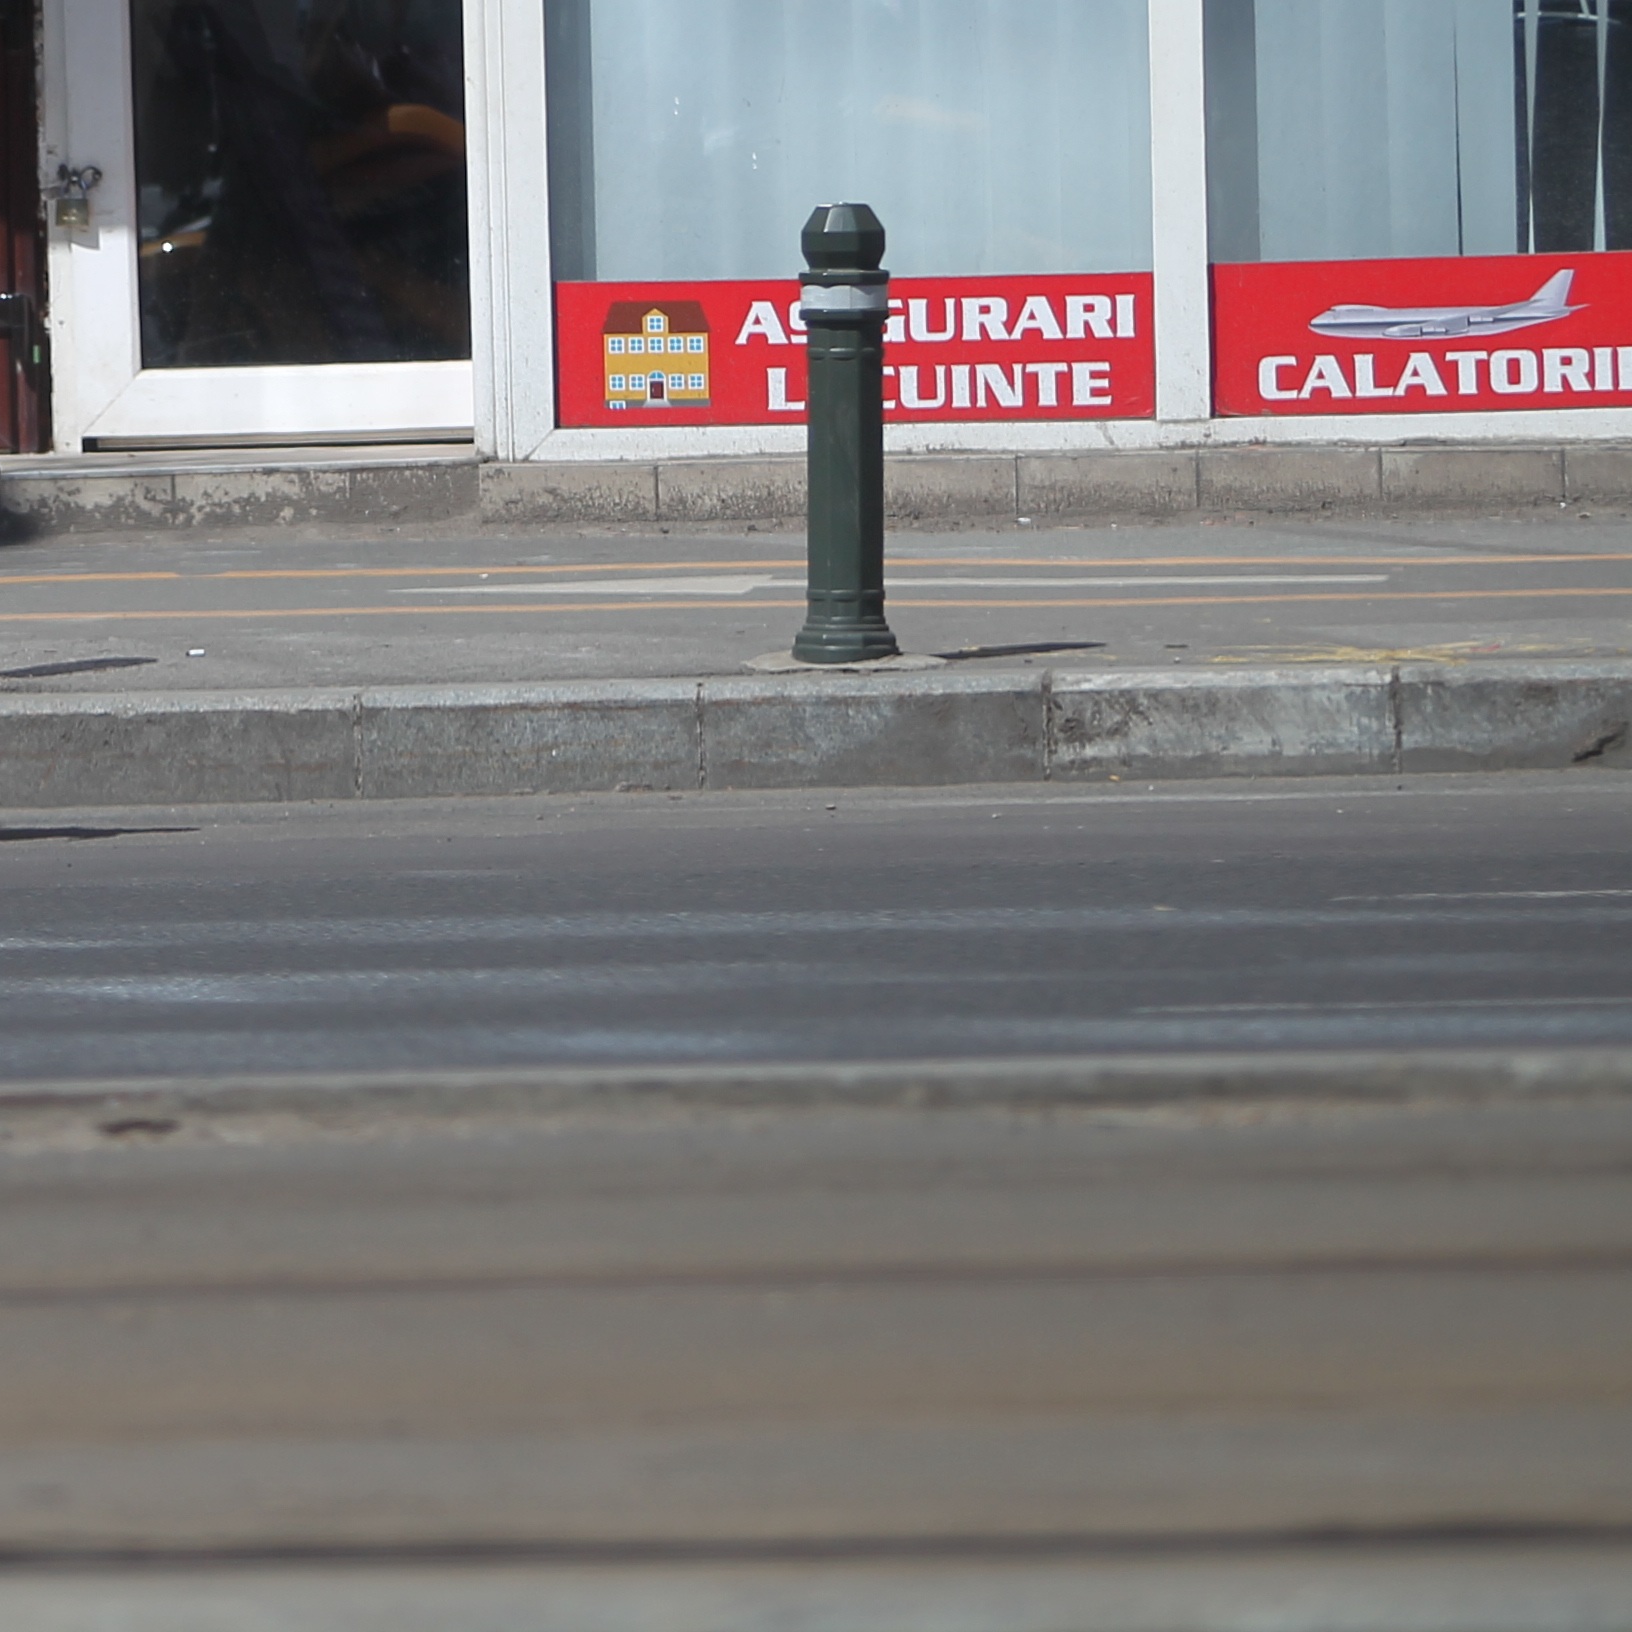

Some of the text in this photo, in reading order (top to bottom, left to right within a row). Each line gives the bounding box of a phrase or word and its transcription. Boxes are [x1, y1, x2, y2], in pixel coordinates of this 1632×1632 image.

[735, 294, 1135, 345] AURARI
[767, 361, 1113, 410] LUINTE
[1258, 346, 1632, 400] CALATORII
